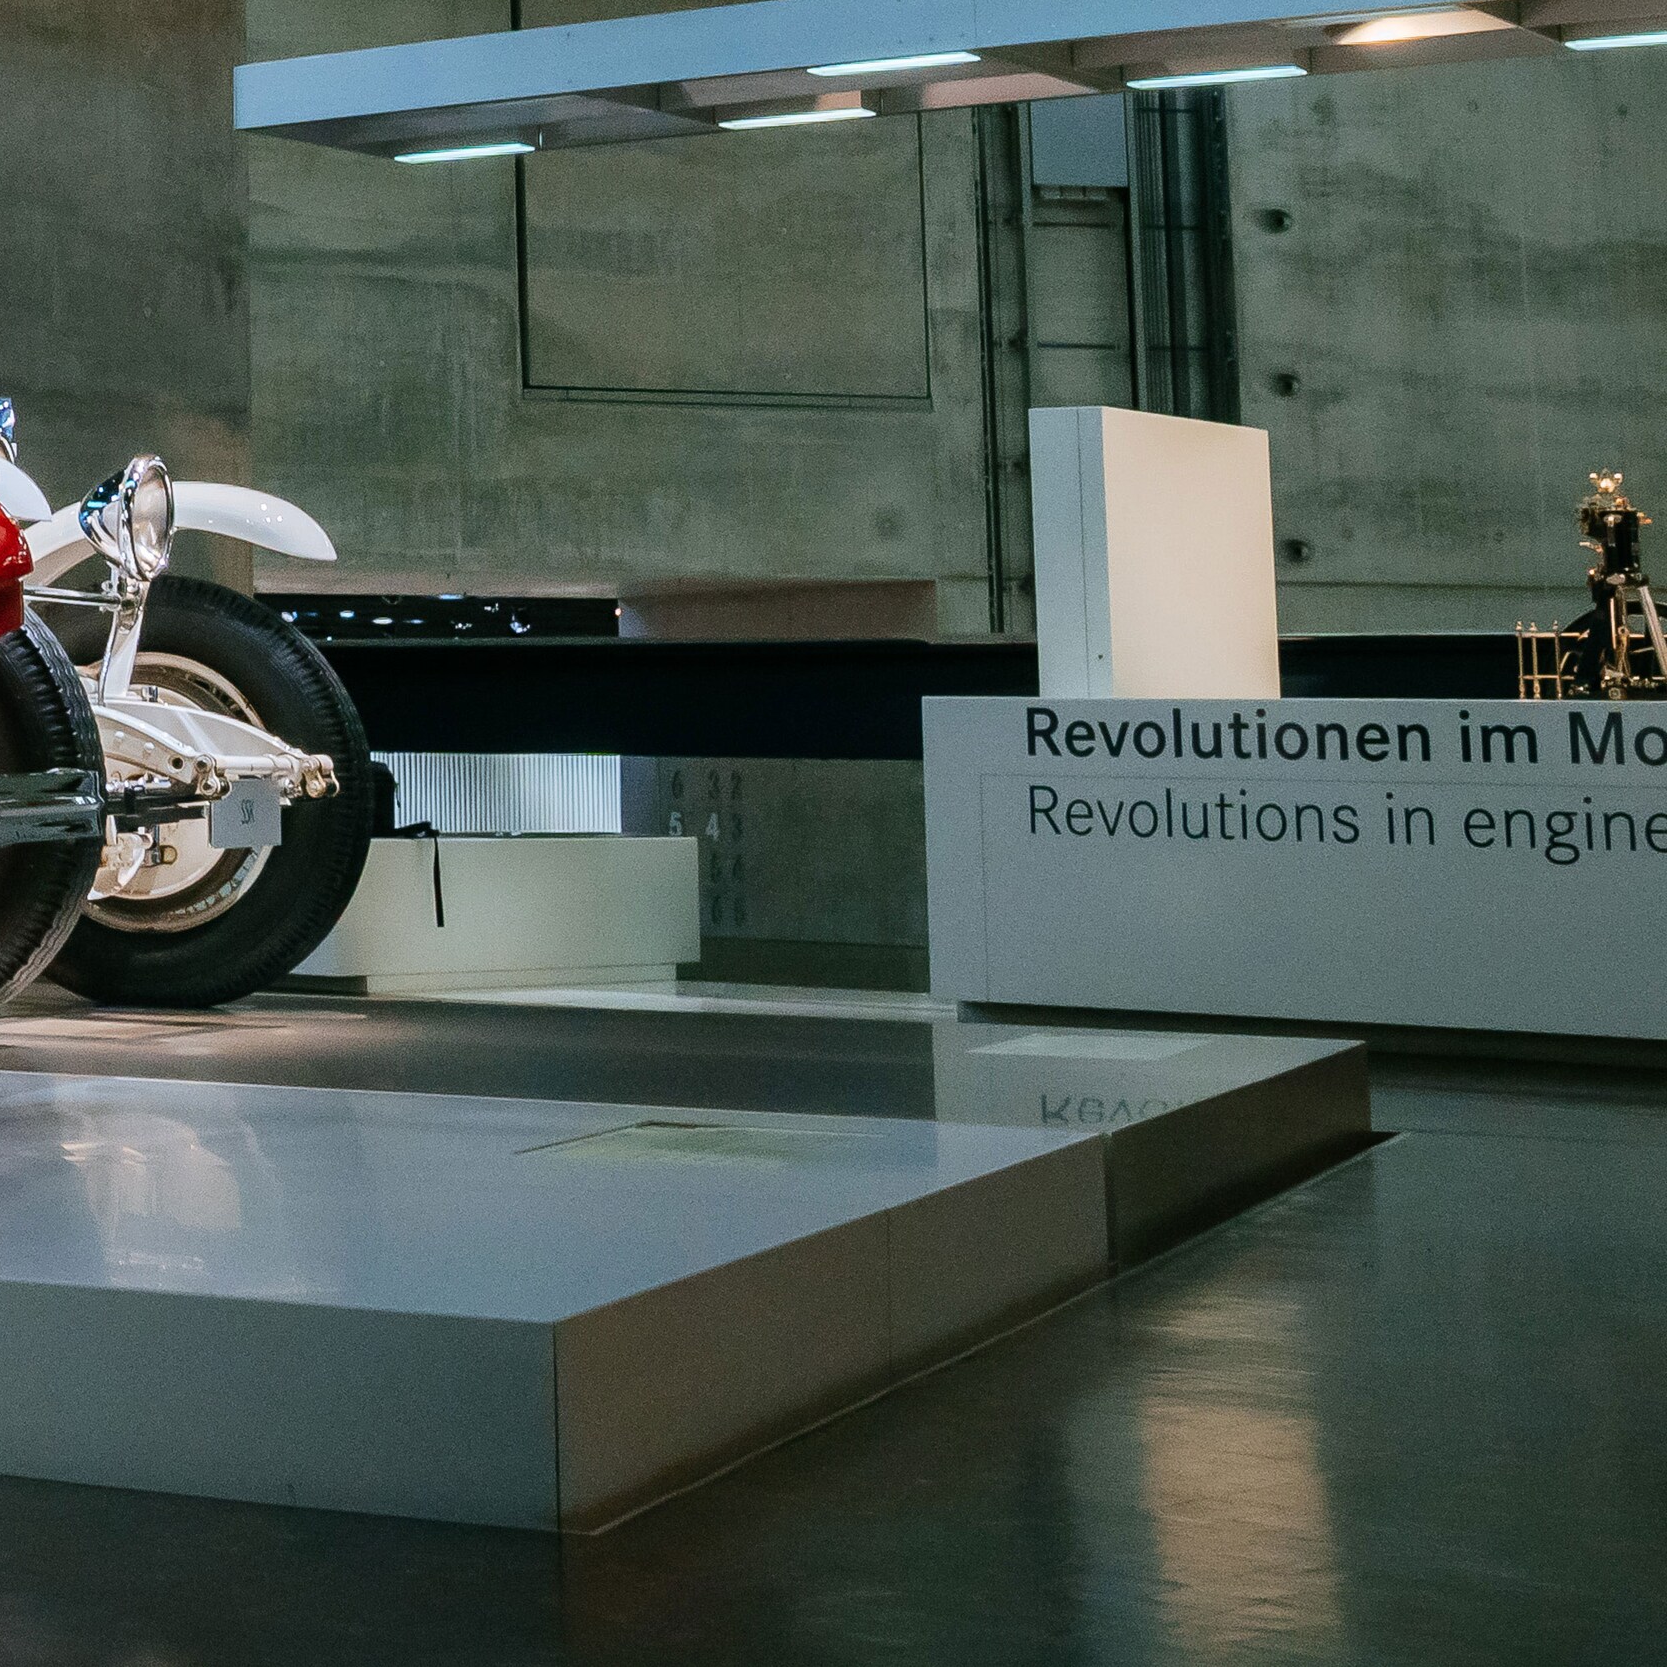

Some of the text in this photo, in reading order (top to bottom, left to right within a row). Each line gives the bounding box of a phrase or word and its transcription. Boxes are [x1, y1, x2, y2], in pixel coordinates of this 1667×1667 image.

[1025, 706, 1433, 764] Revolutionen
[1458, 709, 1540, 765] im
[1027, 784, 1361, 845] Revolutions
[1385, 791, 1437, 847] in
